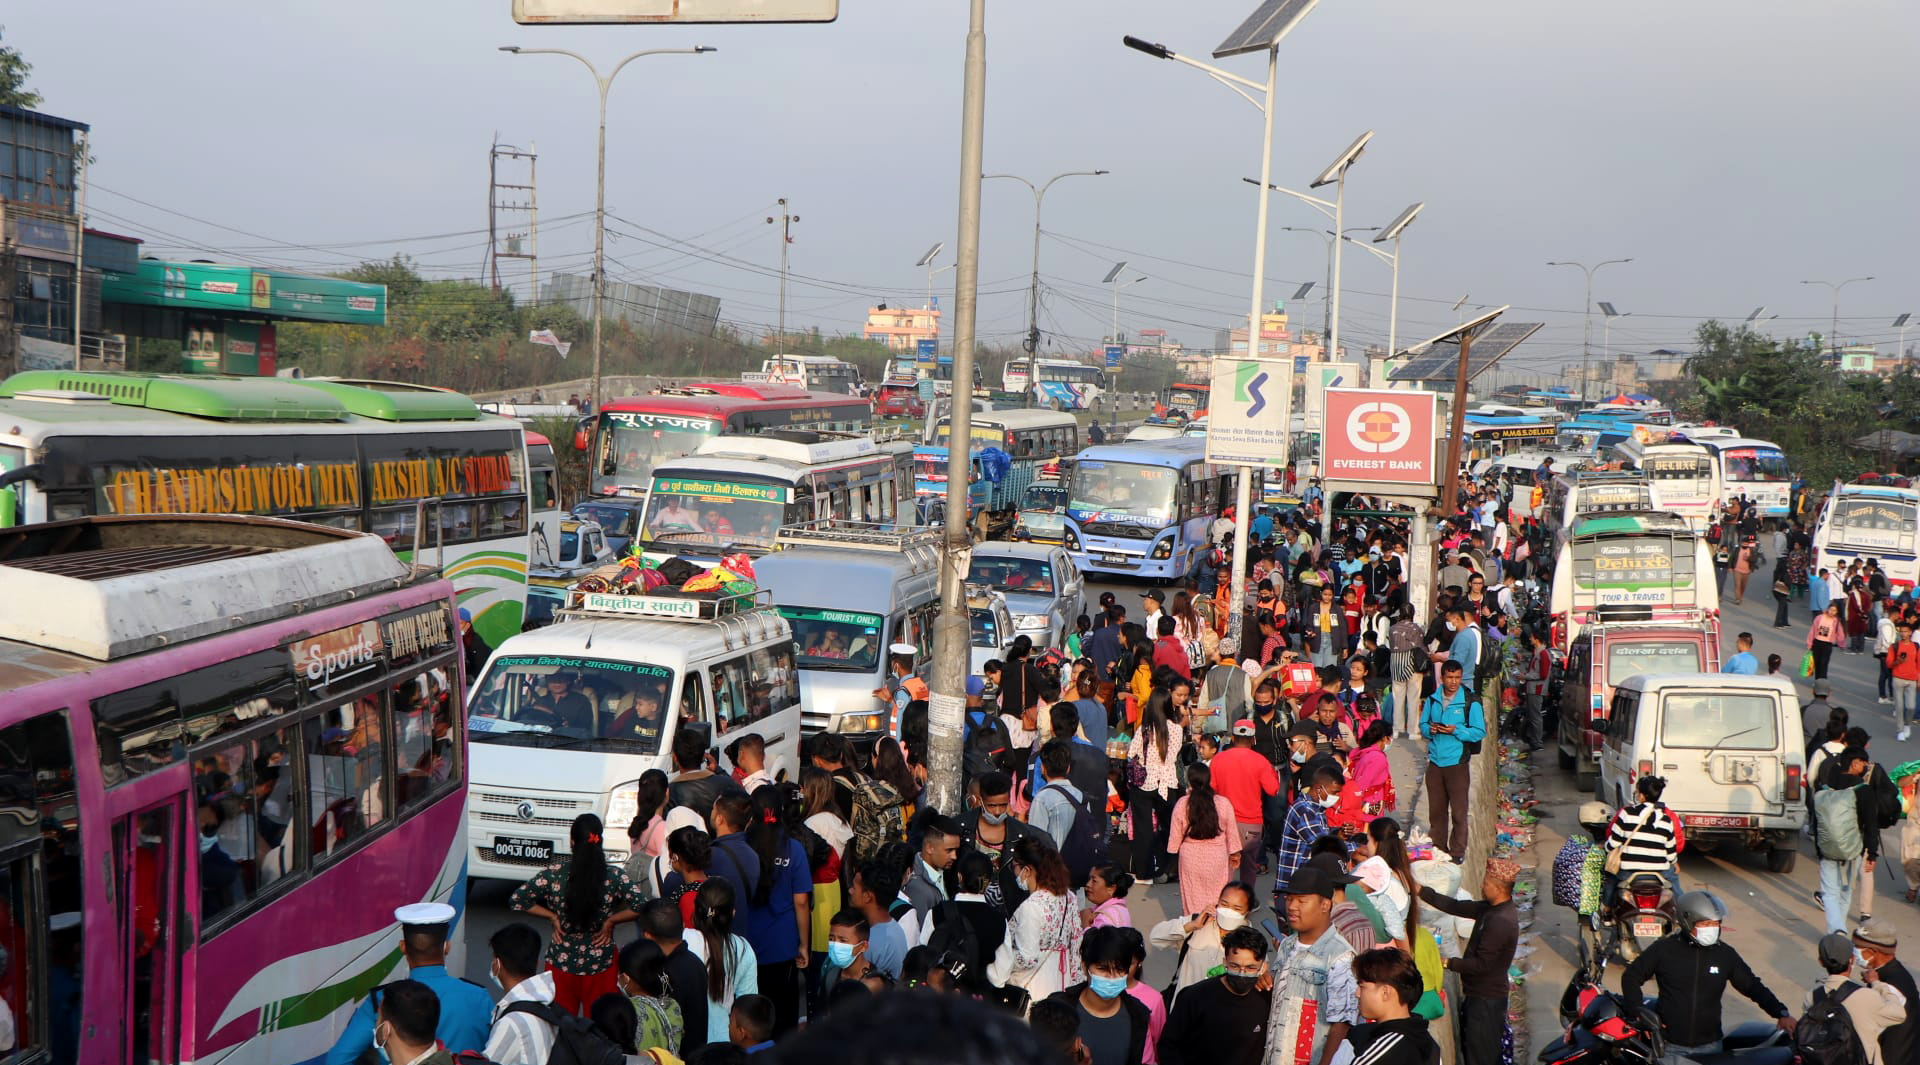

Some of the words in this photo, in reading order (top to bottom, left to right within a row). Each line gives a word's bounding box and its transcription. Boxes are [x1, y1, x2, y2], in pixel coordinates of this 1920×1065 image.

[1333, 459, 1387, 469] EVEREST
[1389, 460, 1423, 470] BANK
[1655, 460, 1698, 471] DELUXE
[115, 464, 313, 514] CHANDESHWORI
[433, 456, 463, 496] A/C
[1601, 593, 1621, 601] TOUR
[1632, 593, 1665, 601] TRAVELS
[650, 599, 694, 613] सवारी
[822, 611, 855, 623] TOURIST
[856, 614, 877, 625] ONLY
[306, 633, 374, 686] Sports
[497, 656, 535, 666] दोलखा
[584, 660, 635, 673] यातायात
